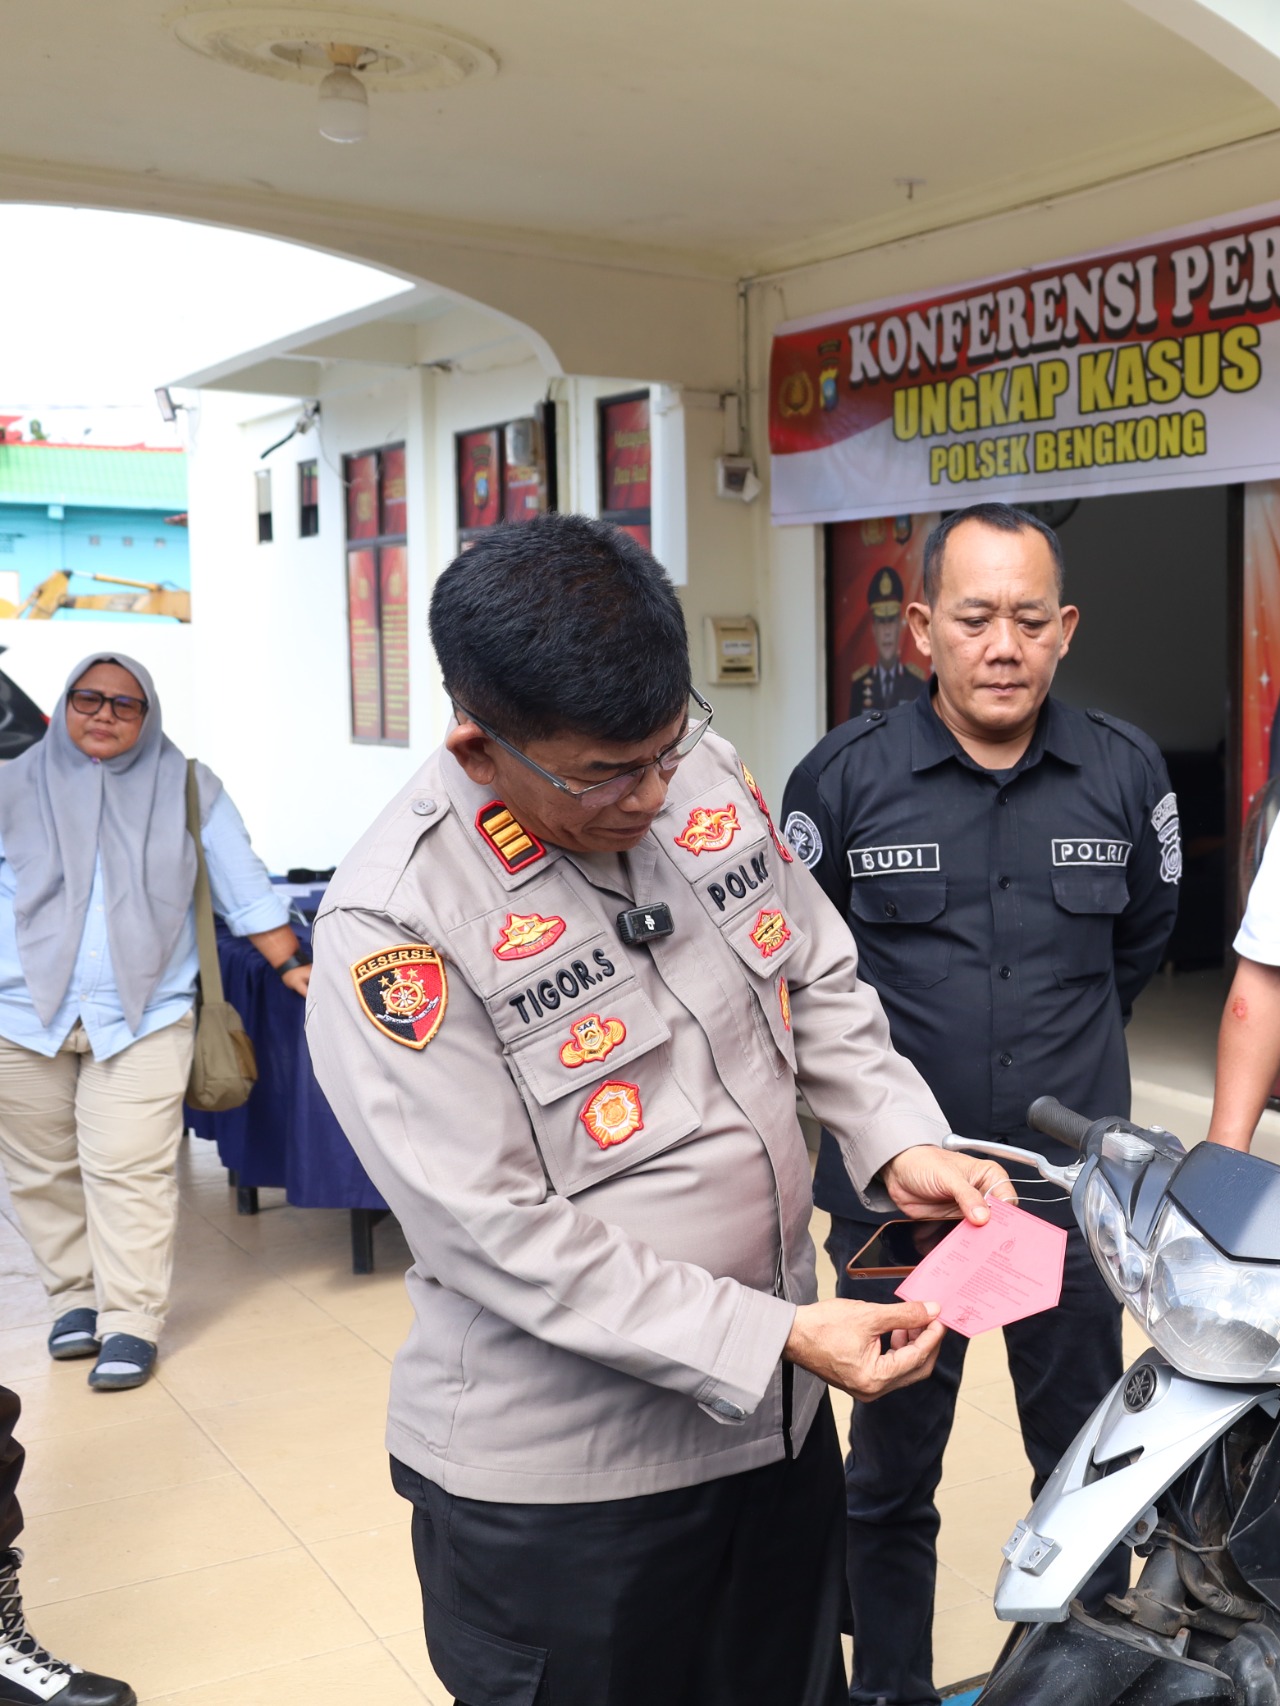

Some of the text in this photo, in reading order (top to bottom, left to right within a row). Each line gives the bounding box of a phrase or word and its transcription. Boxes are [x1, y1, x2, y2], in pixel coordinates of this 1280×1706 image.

[848, 254, 1158, 386] KONFERENSI
[892, 324, 1261, 441] UNGKAP KASUS
[929, 409, 1207, 485] POLSEK BENGKONG
[861, 847, 923, 870] BUDI
[1060, 842, 1124, 863] POLRI
[357, 949, 433, 976] RESERSE
[508, 948, 616, 1025] TIGOR.S
